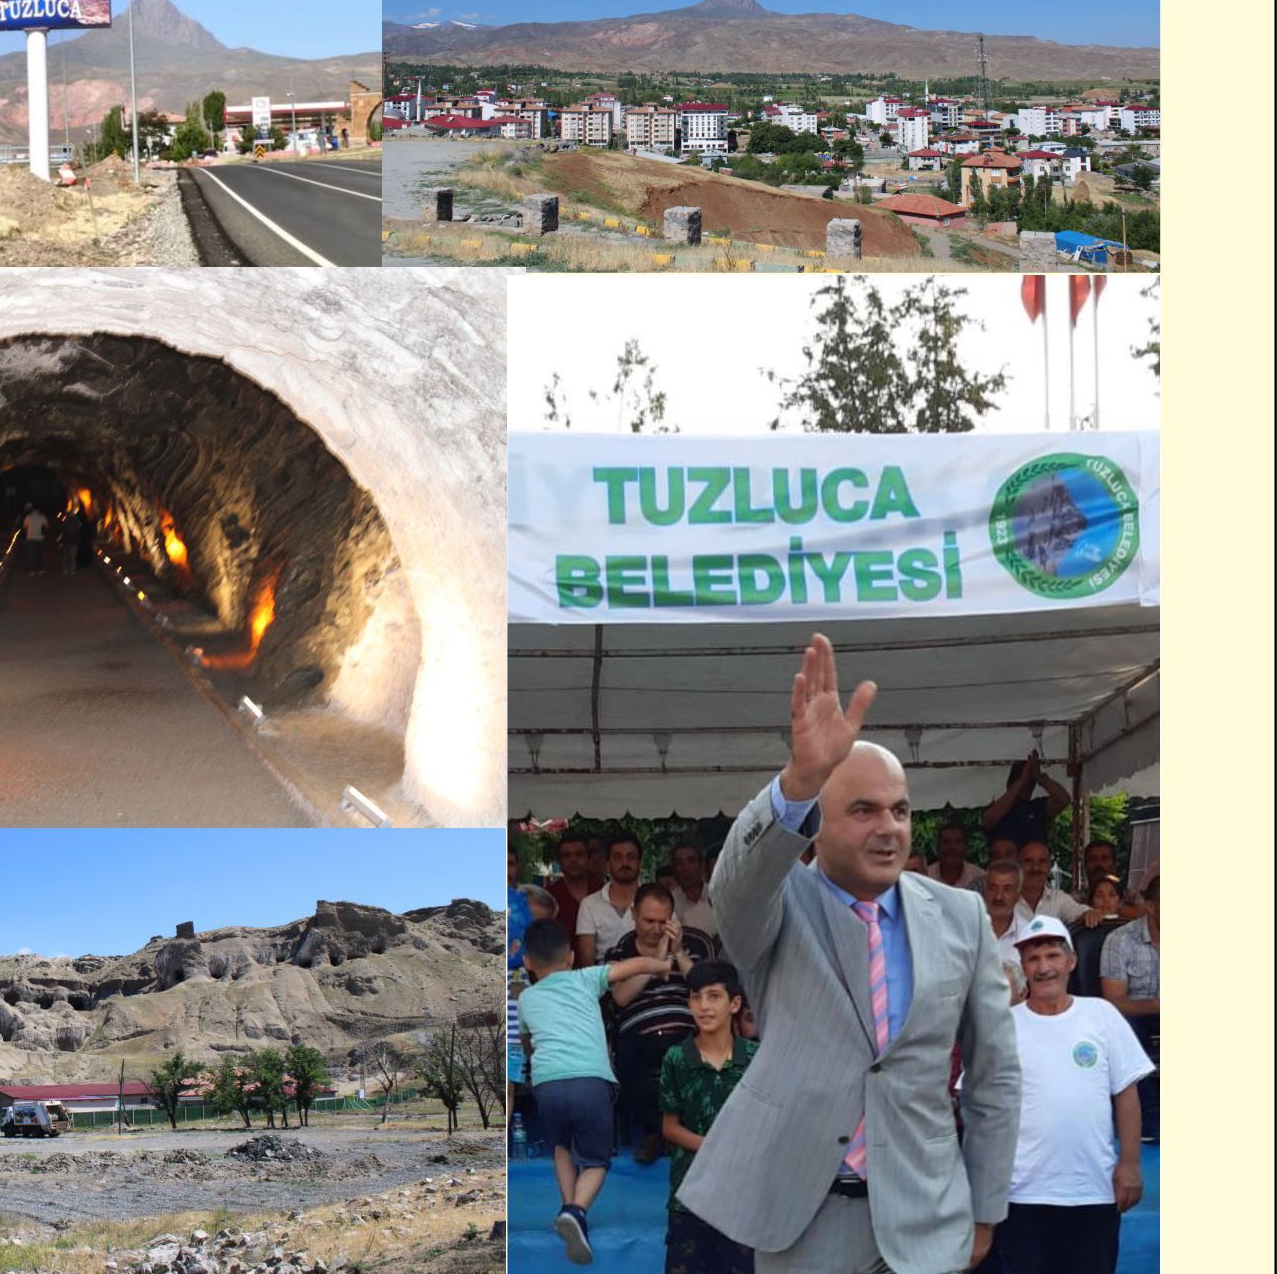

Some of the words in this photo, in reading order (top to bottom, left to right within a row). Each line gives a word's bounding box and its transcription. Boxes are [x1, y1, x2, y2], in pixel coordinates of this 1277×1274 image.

[592, 464, 920, 526] TUZLUCA
[1086, 459, 1131, 508] TUZLUCA
[555, 531, 963, 608] BELEDİYESİ
